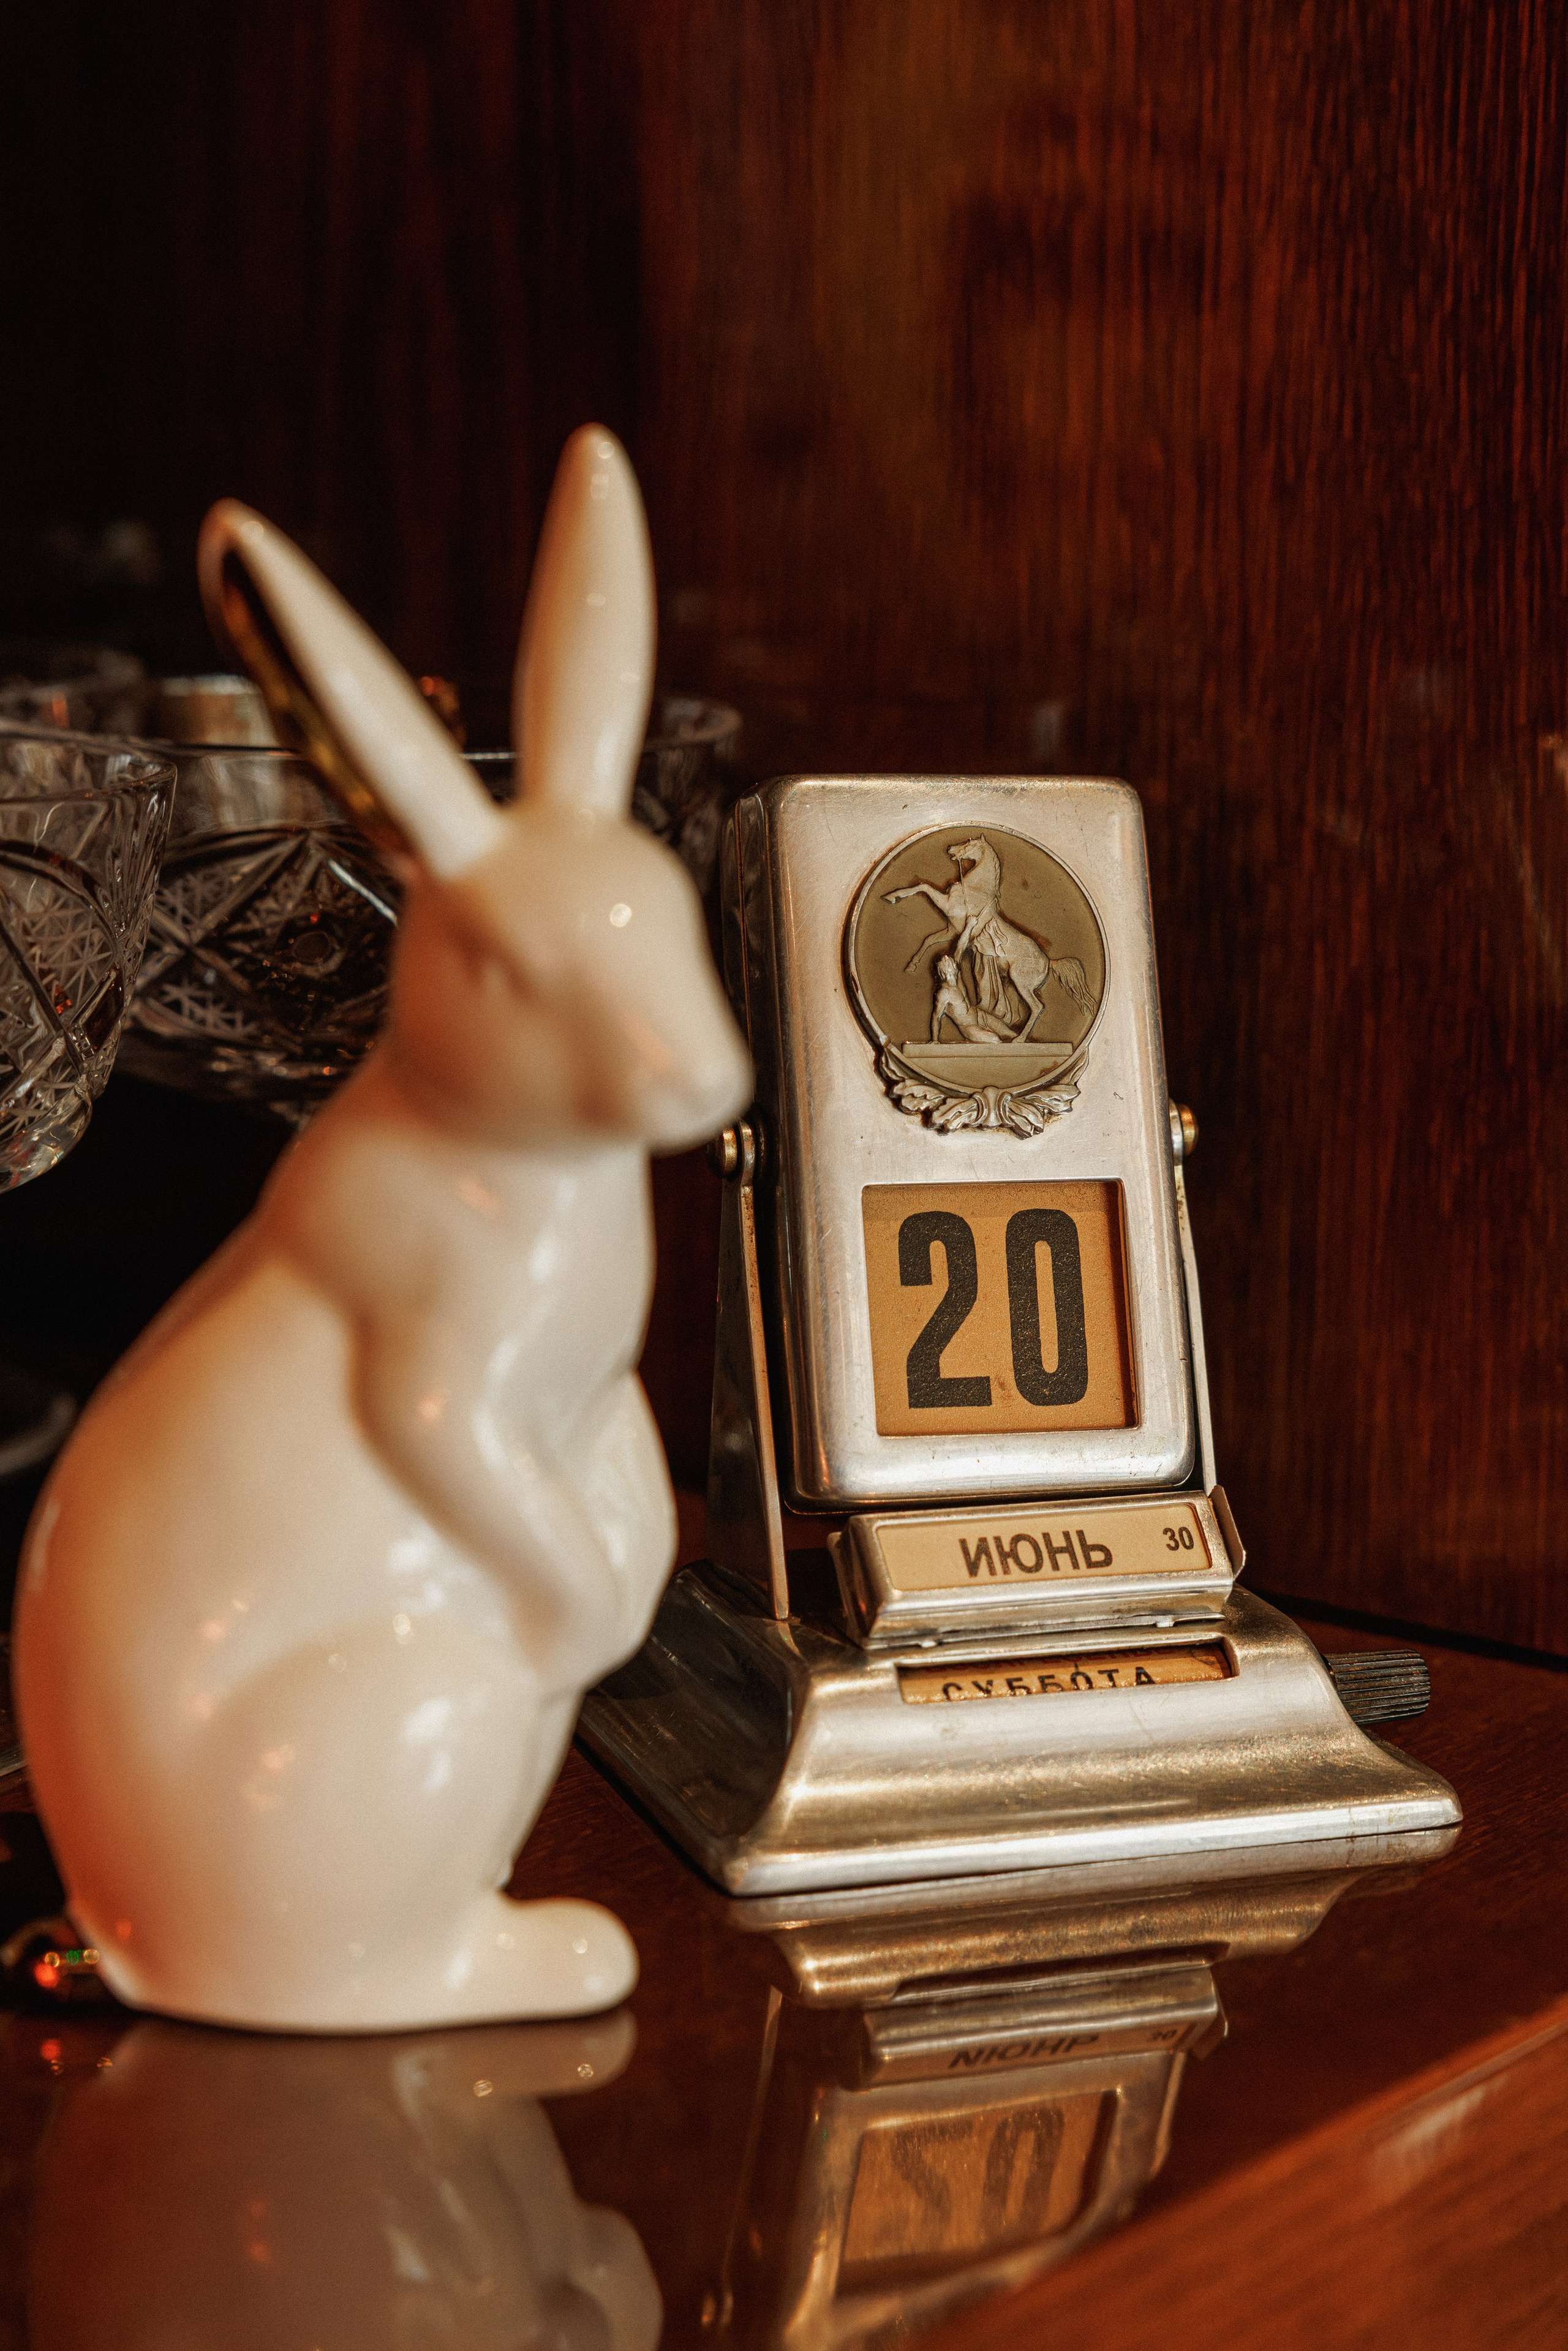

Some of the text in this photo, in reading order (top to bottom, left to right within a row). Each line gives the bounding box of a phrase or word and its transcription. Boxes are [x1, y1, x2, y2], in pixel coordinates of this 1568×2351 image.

[899, 1209, 1088, 1409] 20
[959, 1526, 1194, 1578] ИЮНЬ 30
